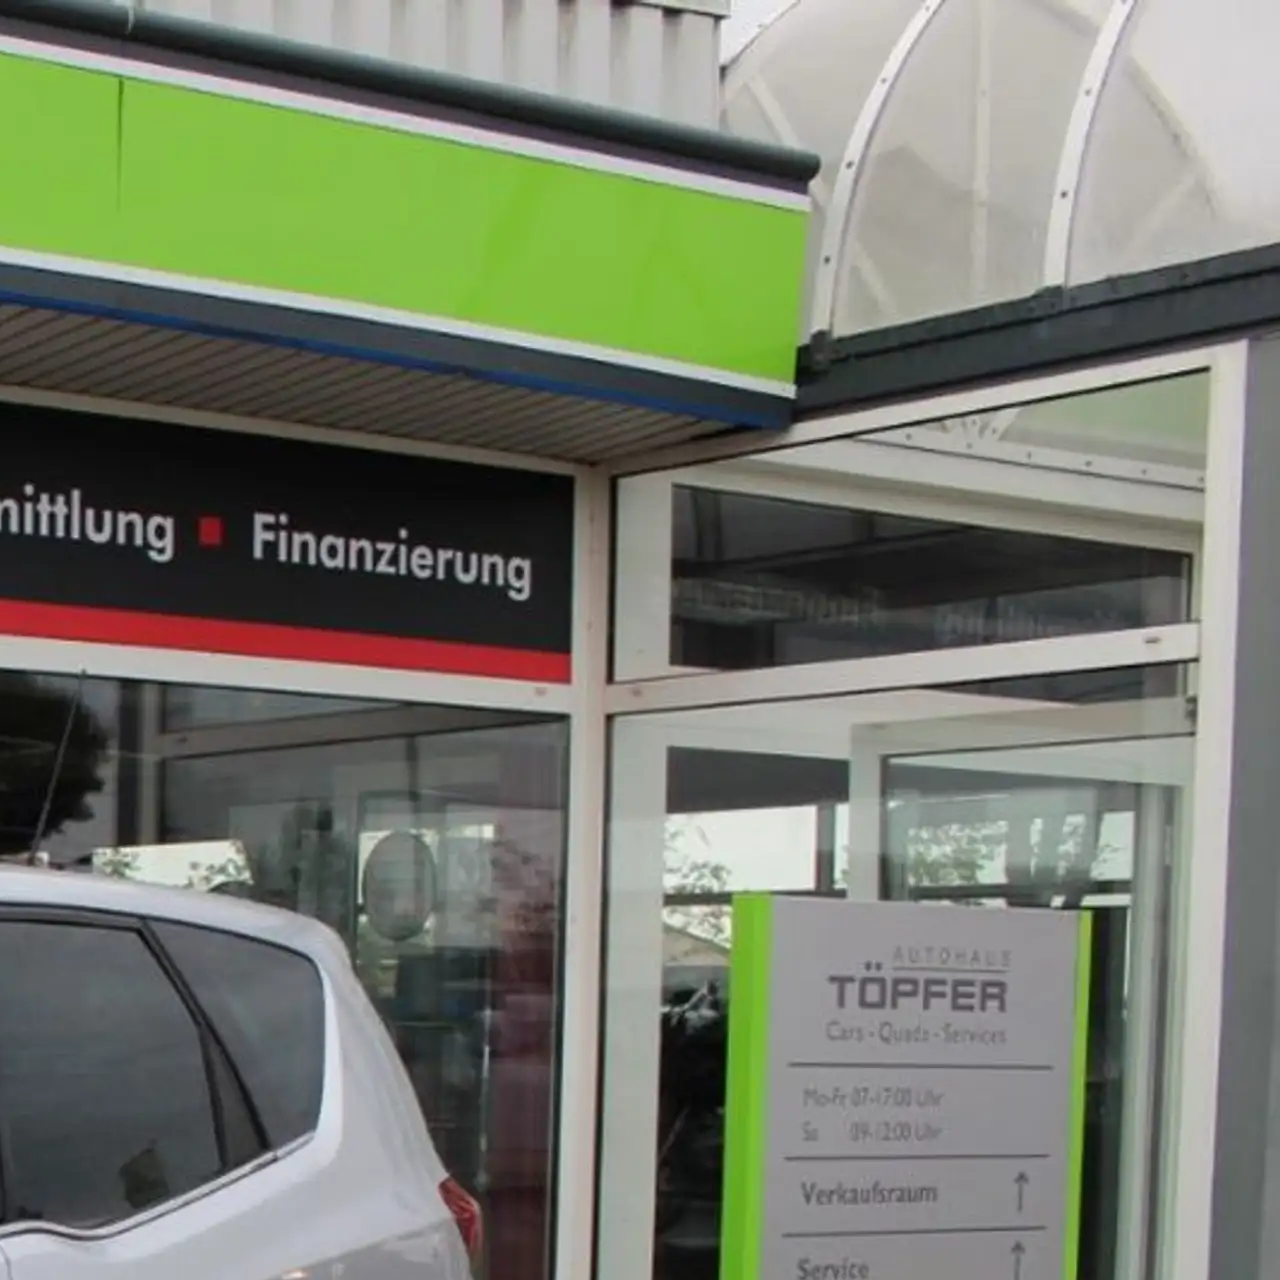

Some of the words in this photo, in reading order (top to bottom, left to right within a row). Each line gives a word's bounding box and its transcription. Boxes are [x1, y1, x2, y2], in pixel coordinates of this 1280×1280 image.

[252, 511, 533, 601] Finanzierung
[892, 945, 1013, 968] AUTOHAUS
[828, 961, 1008, 1012] TÖPFER
[825, 1021, 865, 1041] Cars
[941, 1022, 1008, 1046] Services
[801, 1181, 938, 1206] Verkaufsraum
